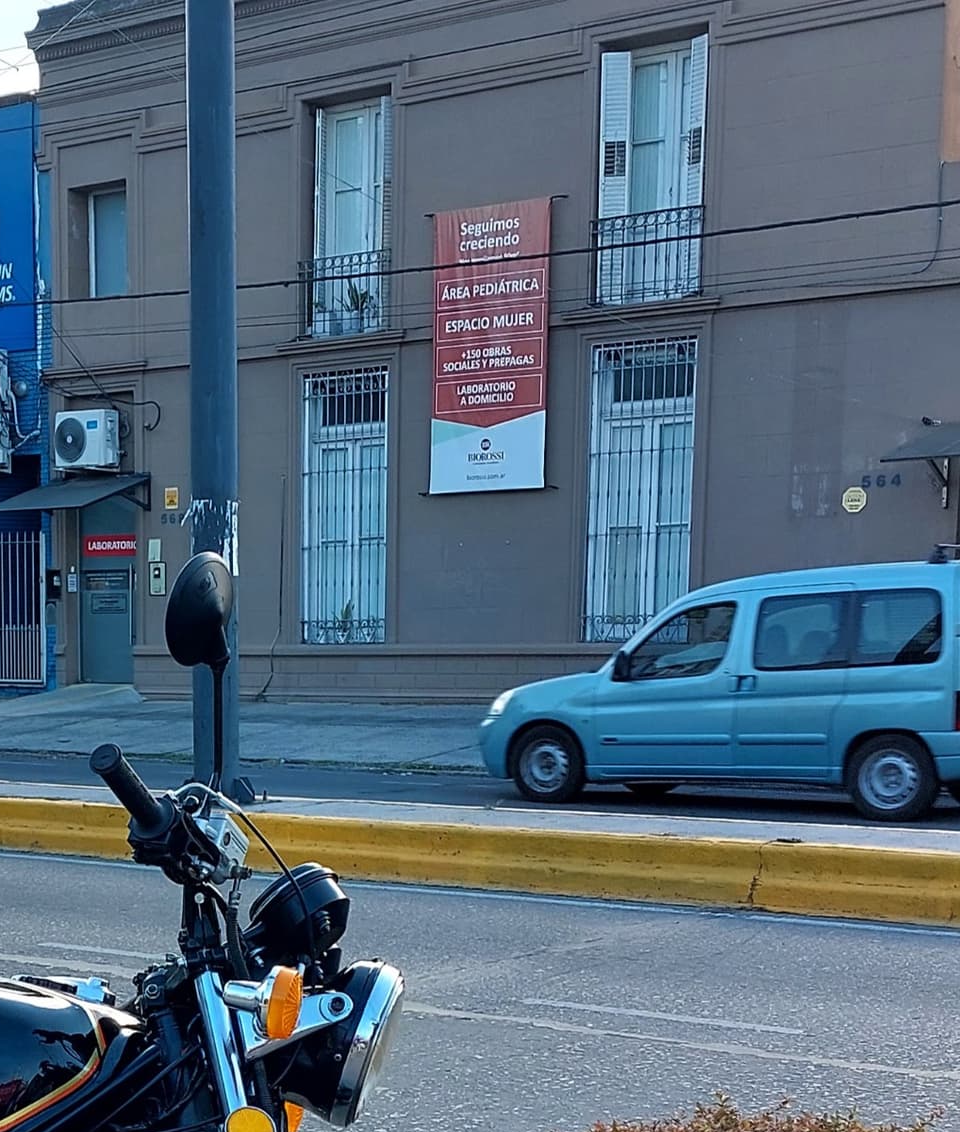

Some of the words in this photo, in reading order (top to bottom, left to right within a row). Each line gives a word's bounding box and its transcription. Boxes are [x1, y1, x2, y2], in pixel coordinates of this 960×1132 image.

[460, 217, 520, 237] Seguimos
[459, 231, 520, 252] creciendo
[441, 281, 470, 301] ÁREA
[472, 276, 539, 298] PEDIÁTRICA
[445, 315, 490, 333] ESPACIO
[493, 311, 534, 329] MUJER
[461, 348, 481, 360] +150
[482, 345, 512, 358] OBRAS
[443, 358, 480, 372] SOCIALES
[481, 358, 488, 368] Y
[489, 354, 535, 368] PREPAGAS
[456, 381, 516, 396] LABORATORIO
[460, 396, 467, 406] A
[468, 392, 514, 405] DOMICILIO
[861, 474, 902, 489] 564
